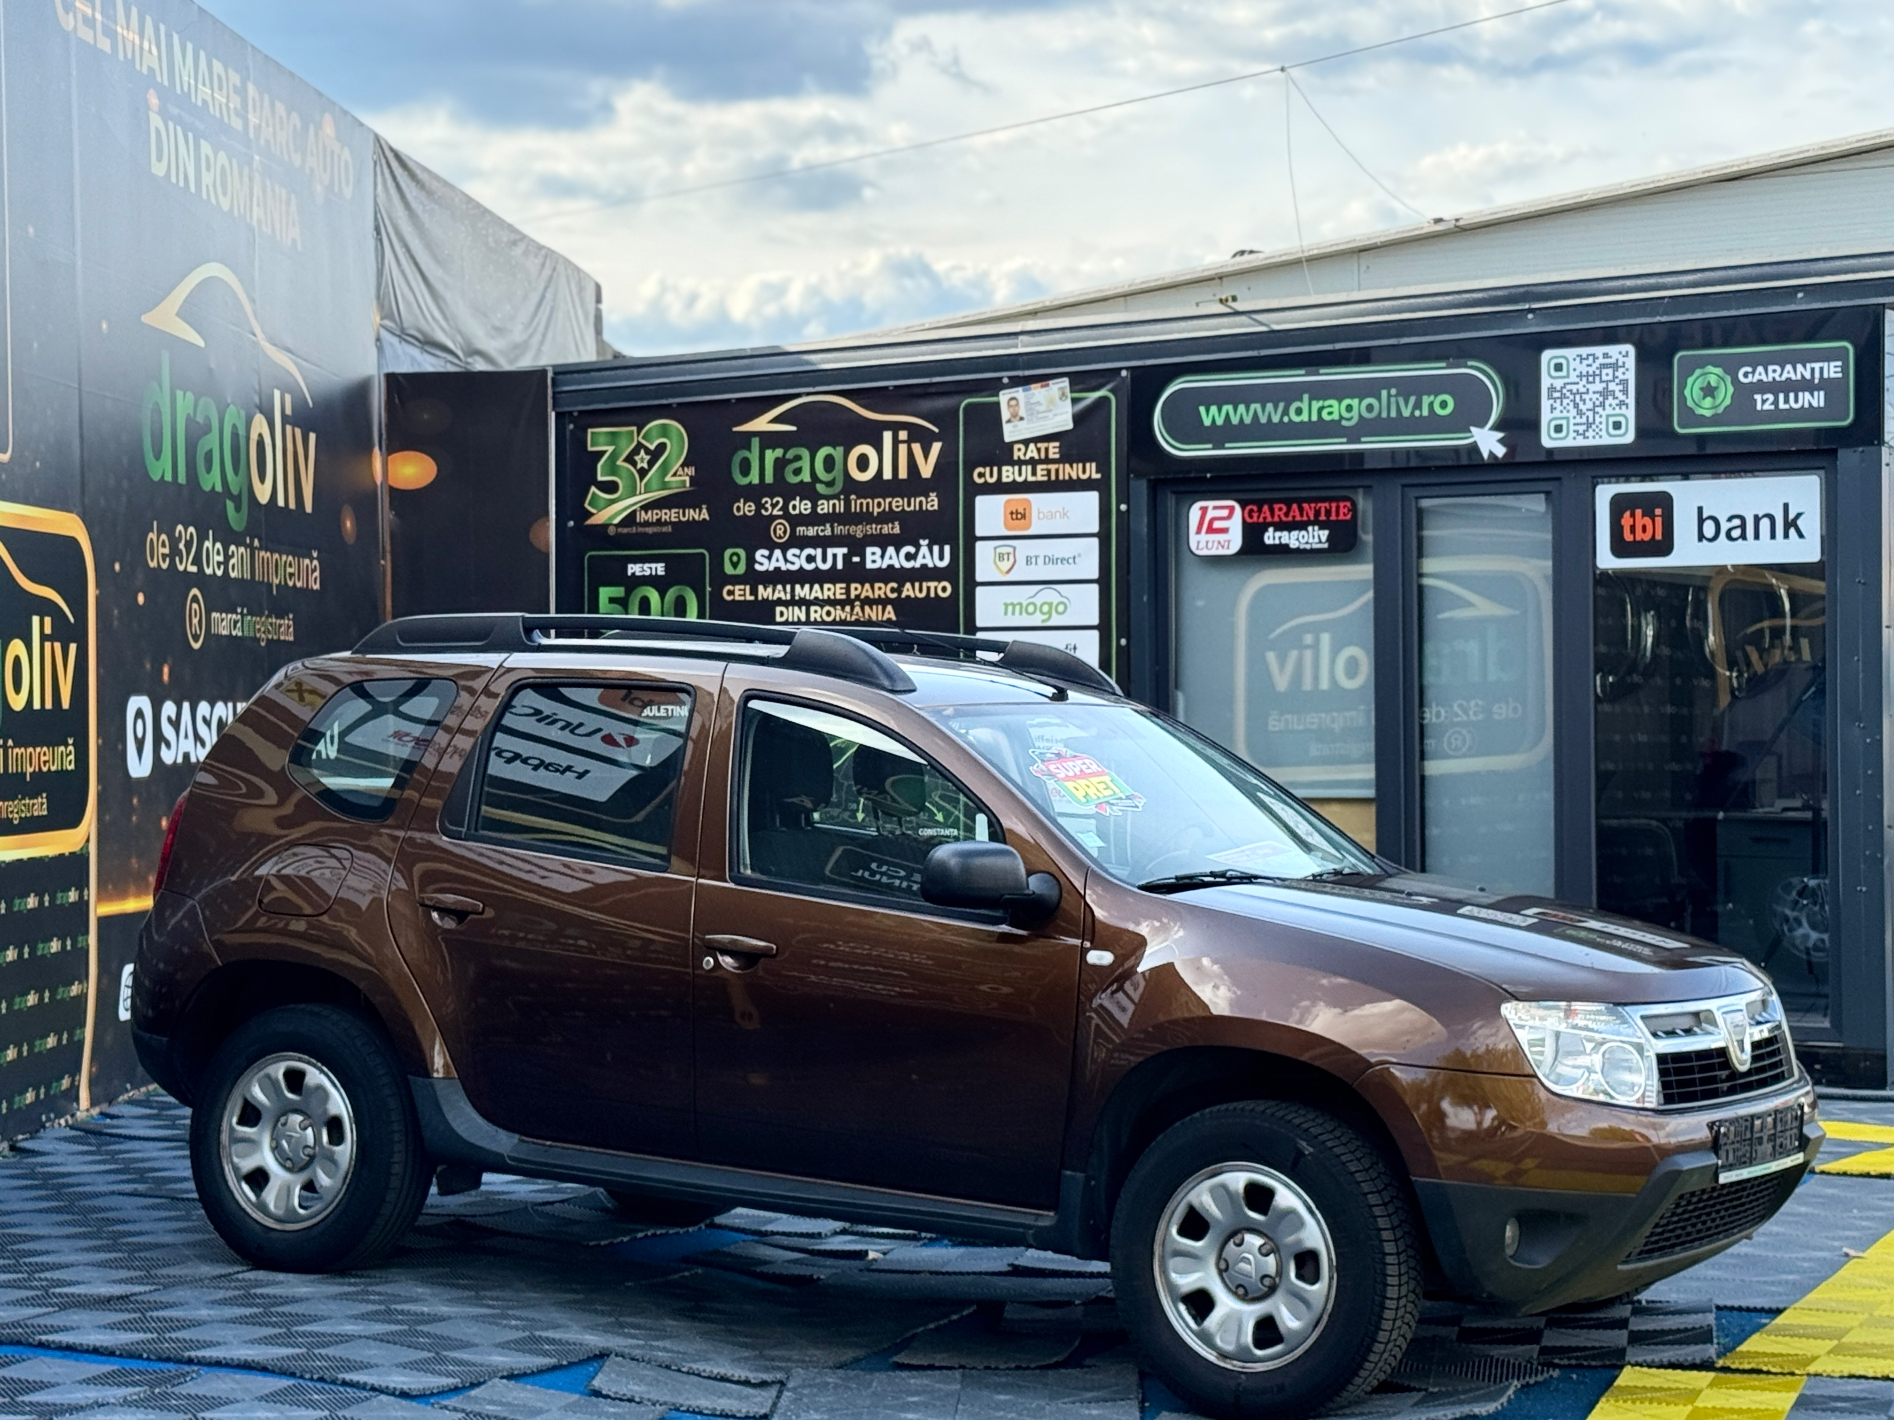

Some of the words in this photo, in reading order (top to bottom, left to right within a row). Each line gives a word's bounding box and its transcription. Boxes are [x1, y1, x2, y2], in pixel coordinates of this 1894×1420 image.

[56, 0, 112, 54] CEL
[116, 0, 168, 87] MAI
[173, 32, 243, 132] MARE
[247, 82, 301, 168] PARC
[305, 123, 353, 200] AUTO
[149, 111, 196, 194] DIN
[1199, 388, 1455, 427] www.dragoliv.ro
[1754, 393, 1775, 411] 12
[1779, 390, 1825, 410] LUNI
[141, 349, 317, 532] dragoliv
[1013, 442, 1061, 460] RATE
[584, 419, 690, 513] 32
[676, 466, 696, 477] ANI
[730, 430, 943, 496] dragoliv
[973, 467, 998, 484] CU
[1001, 462, 1102, 483] BULETINUL
[733, 499, 756, 516] de
[760, 499, 784, 516] 32
[788, 496, 812, 515] de
[817, 495, 845, 514] ani
[850, 492, 939, 518] împreună
[1009, 504, 1027, 521] tbi
[1037, 506, 1070, 521] bank
[1243, 501, 1353, 523] GARANTIE
[796, 522, 832, 537] marcă
[1195, 505, 1236, 535] 12
[1621, 508, 1663, 542] tbi
[1697, 503, 1806, 543] bank
[1196, 539, 1232, 551] LUNI
[1264, 525, 1330, 549] dragoliv
[146, 520, 170, 569] de
[175, 524, 198, 573] 32
[203, 530, 225, 577] de
[228, 537, 251, 580] ani
[754, 547, 848, 572] SASCUT
[865, 539, 951, 571] BACĂU
[997, 551, 1013, 563] BT
[1025, 555, 1040, 567] BT
[627, 563, 666, 577] PESTE
[722, 585, 755, 601] CEL
[758, 584, 791, 601] MAI
[794, 583, 847, 600] MARE
[850, 582, 898, 599] PARC
[901, 581, 952, 599] AUTO
[211, 602, 242, 636] marcă
[775, 606, 806, 623] DIN
[811, 600, 897, 622] ROMÂNIA
[1003, 598, 1069, 624] mogo
[0, 615, 78, 712] oliv
[1048, 758, 1102, 779] SUPER
